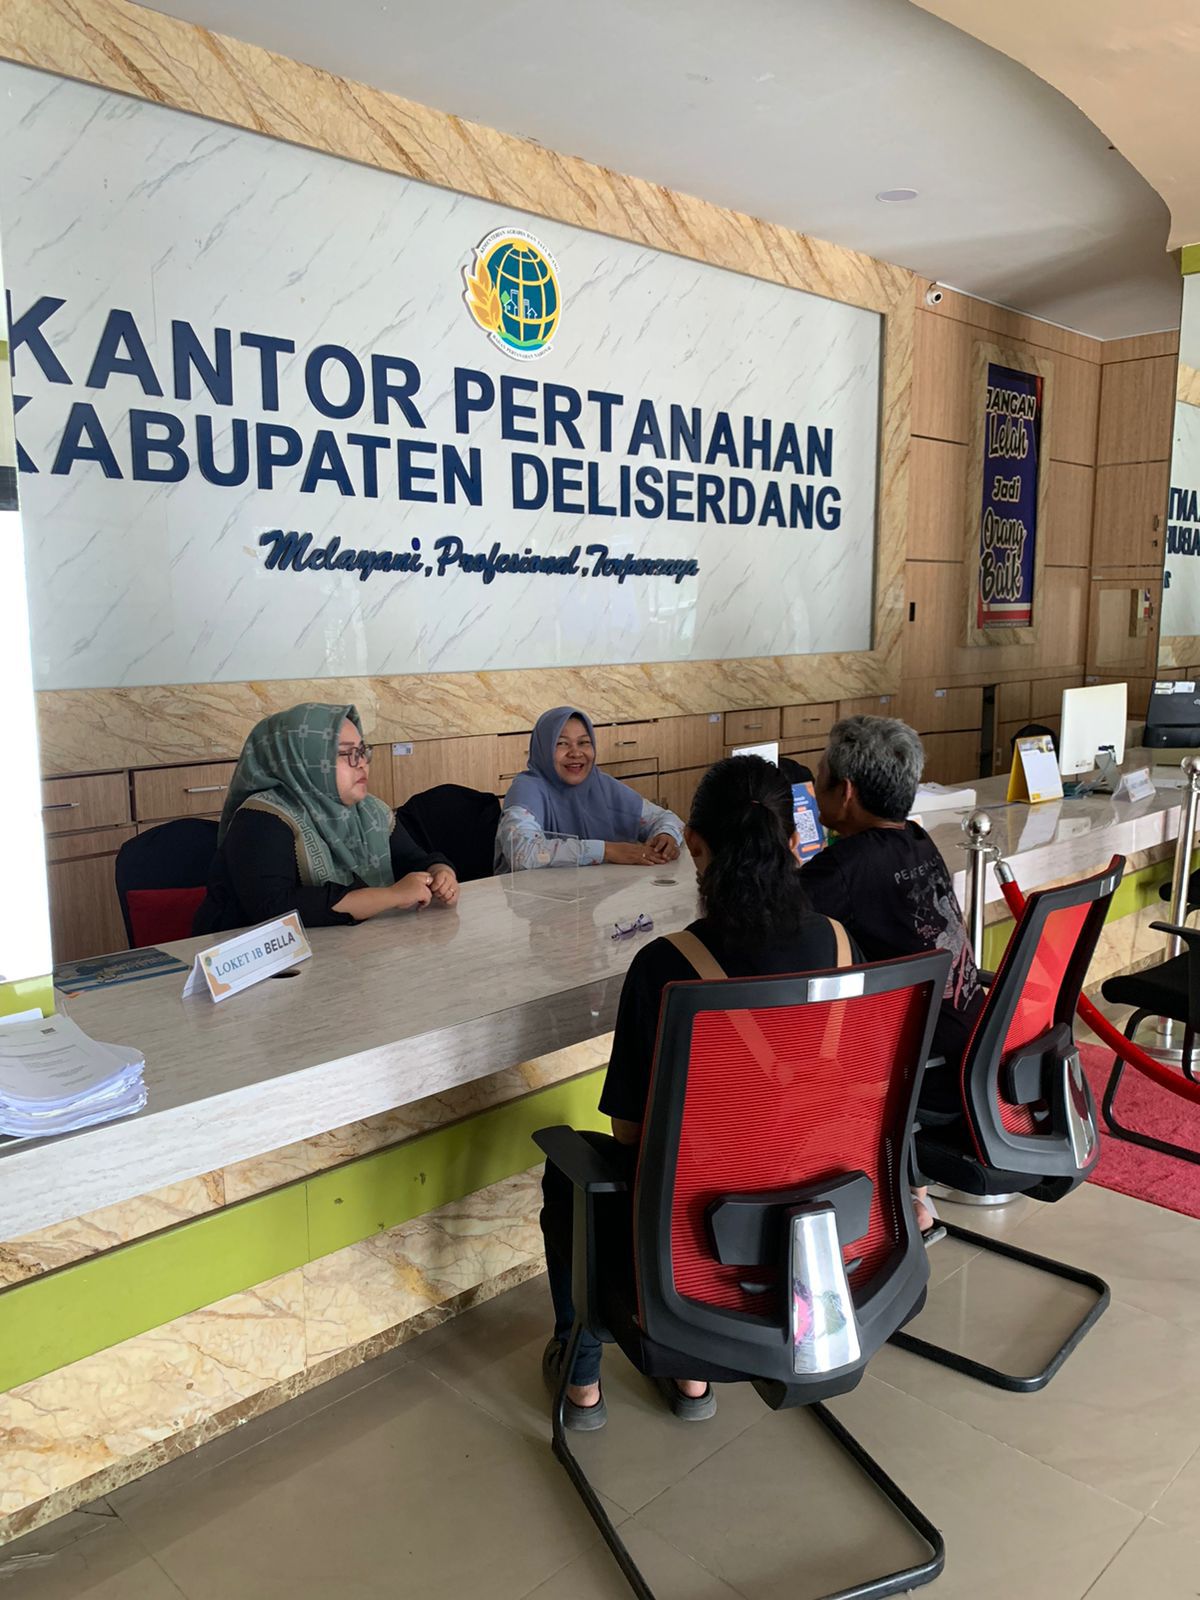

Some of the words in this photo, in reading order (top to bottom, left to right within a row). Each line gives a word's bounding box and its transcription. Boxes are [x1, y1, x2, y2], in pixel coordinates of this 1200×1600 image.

[6, 289, 425, 429] KANTOR
[454, 367, 833, 477] PERTANAHAN
[986, 386, 1036, 421] JANGAN
[988, 412, 1028, 459] Lelah
[511, 452, 841, 531] DELISERDANG
[992, 475, 1021, 502] Jadi
[982, 506, 1027, 564] Orang
[980, 548, 1023, 603] Baik
[215, 951, 250, 977] LOKET
[263, 931, 296, 955] BELLA
